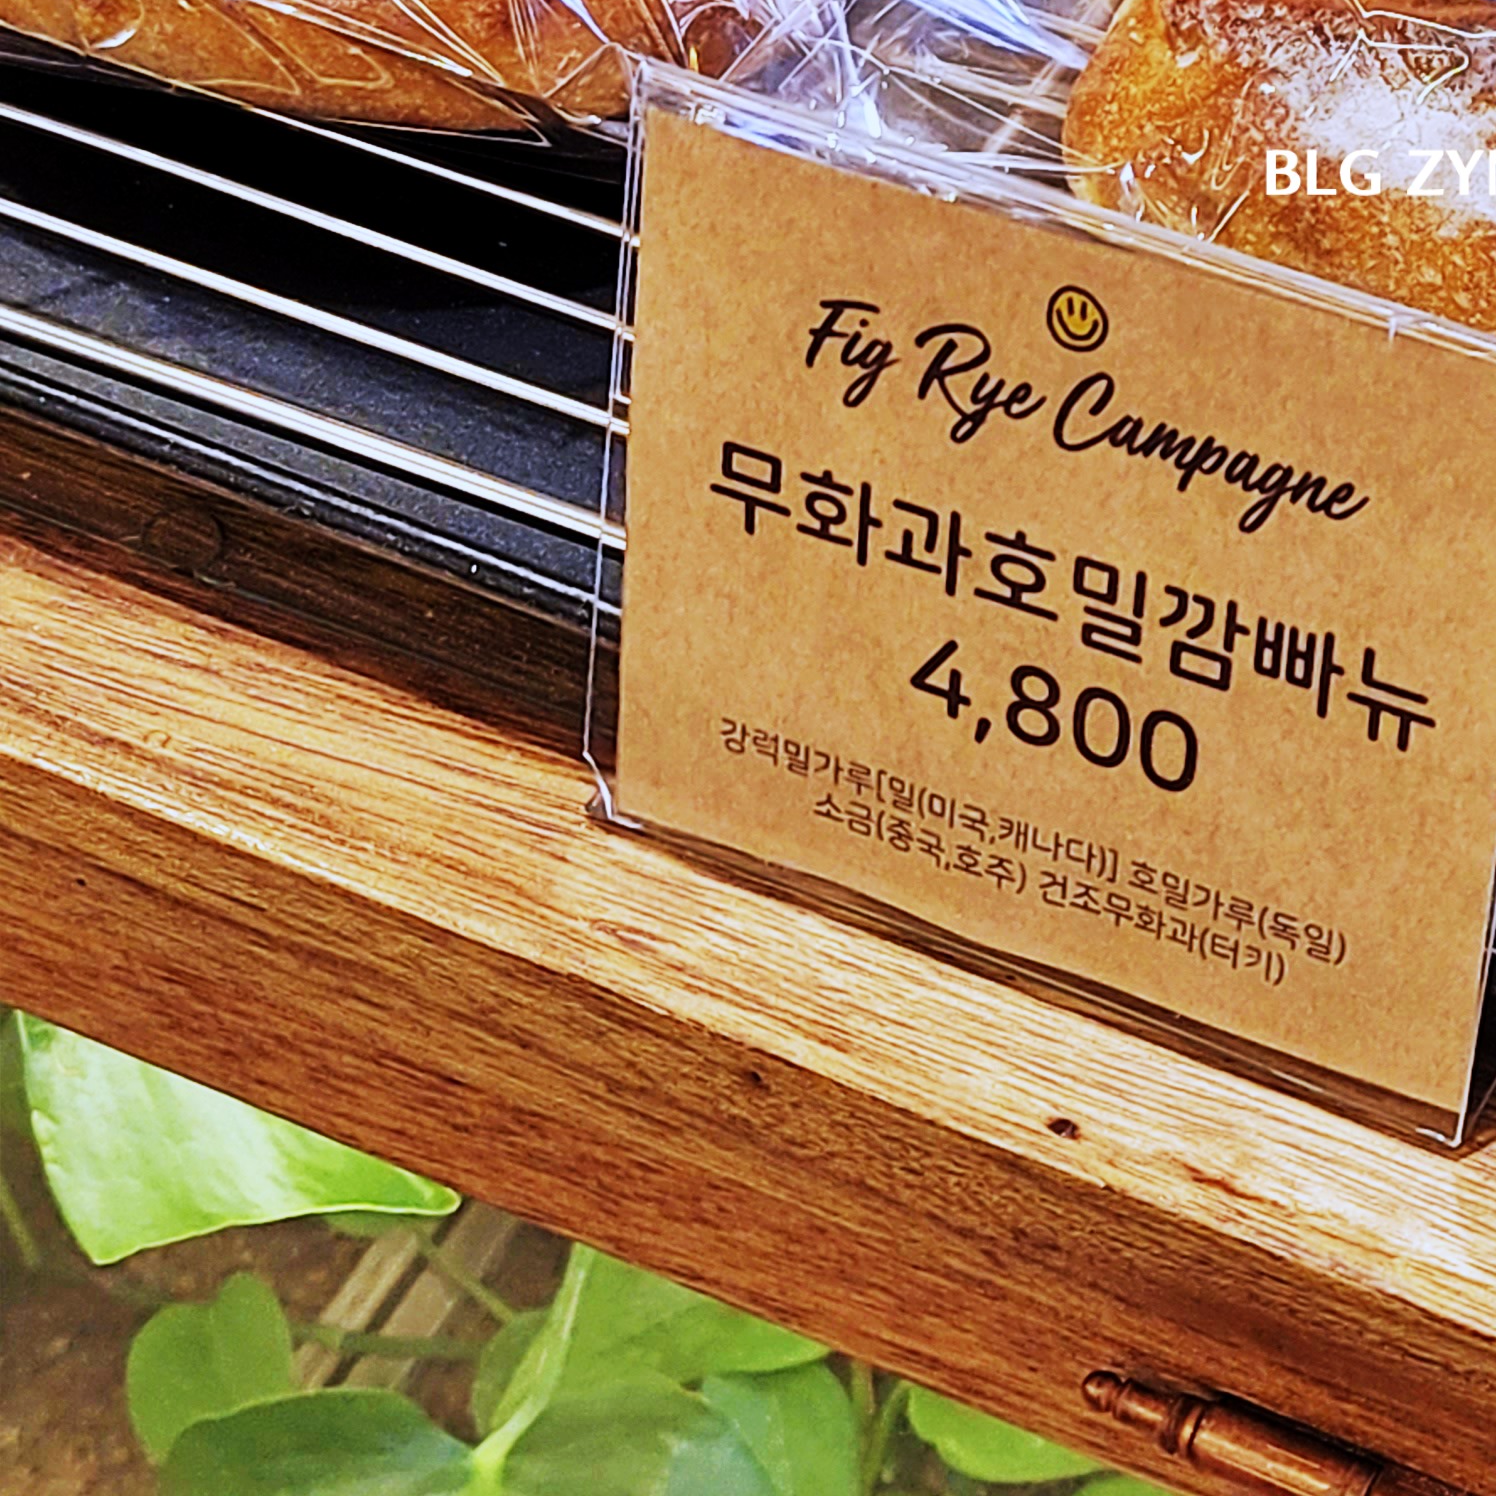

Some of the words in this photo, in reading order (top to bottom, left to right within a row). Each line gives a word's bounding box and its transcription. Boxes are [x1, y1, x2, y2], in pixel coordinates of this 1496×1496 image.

[803, 299, 903, 408] Fig
[913, 322, 1049, 444] Rye
[1051, 371, 1369, 534] Campagne
[708, 440, 1437, 752] 무화과호밀깜빠뉴
[909, 638, 1200, 793] 4,800
[813, 792, 1028, 894] 소금(중국,호주)
[1039, 870, 1286, 986] 건조무화과(터키)
[1128, 859, 1347, 966] 호밀가루(독일)
